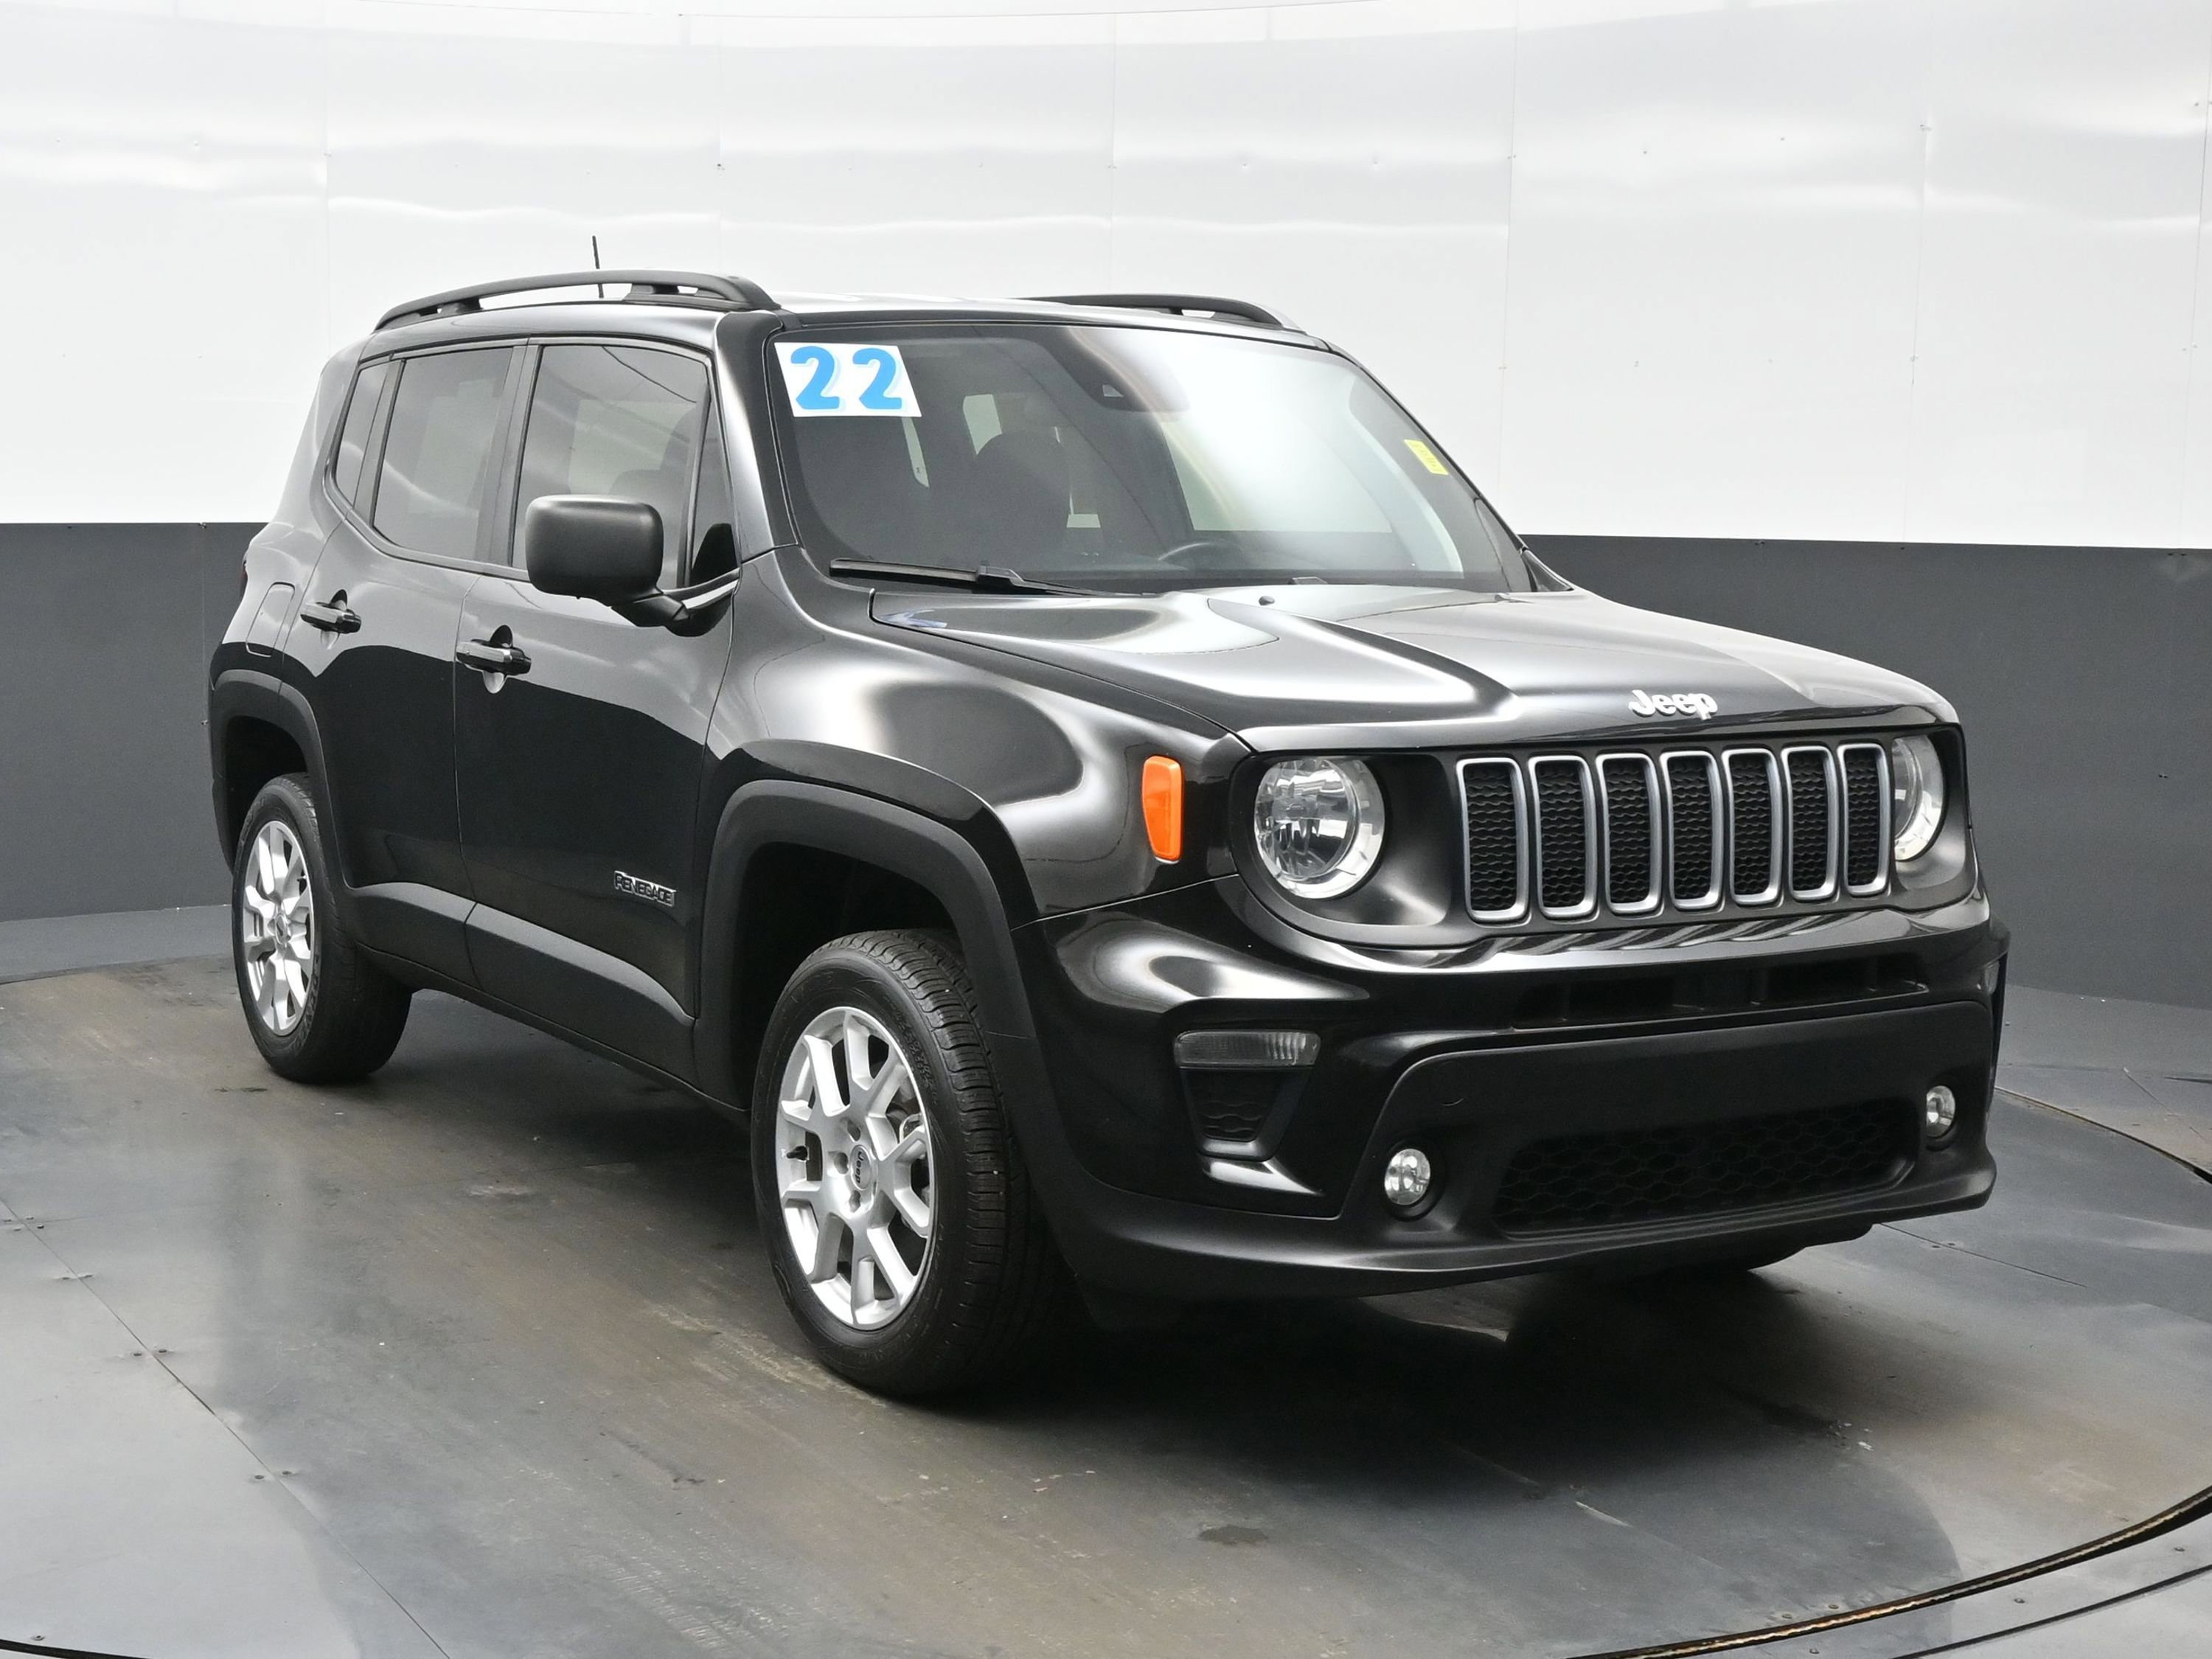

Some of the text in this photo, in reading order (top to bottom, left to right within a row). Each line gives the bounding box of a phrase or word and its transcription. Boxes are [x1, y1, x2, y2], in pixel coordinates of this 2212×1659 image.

[790, 345, 902, 410] 22
[1628, 689, 1718, 720] Jeep
[614, 870, 676, 907] RENEGADE
[854, 1151, 865, 1184] Jeep
